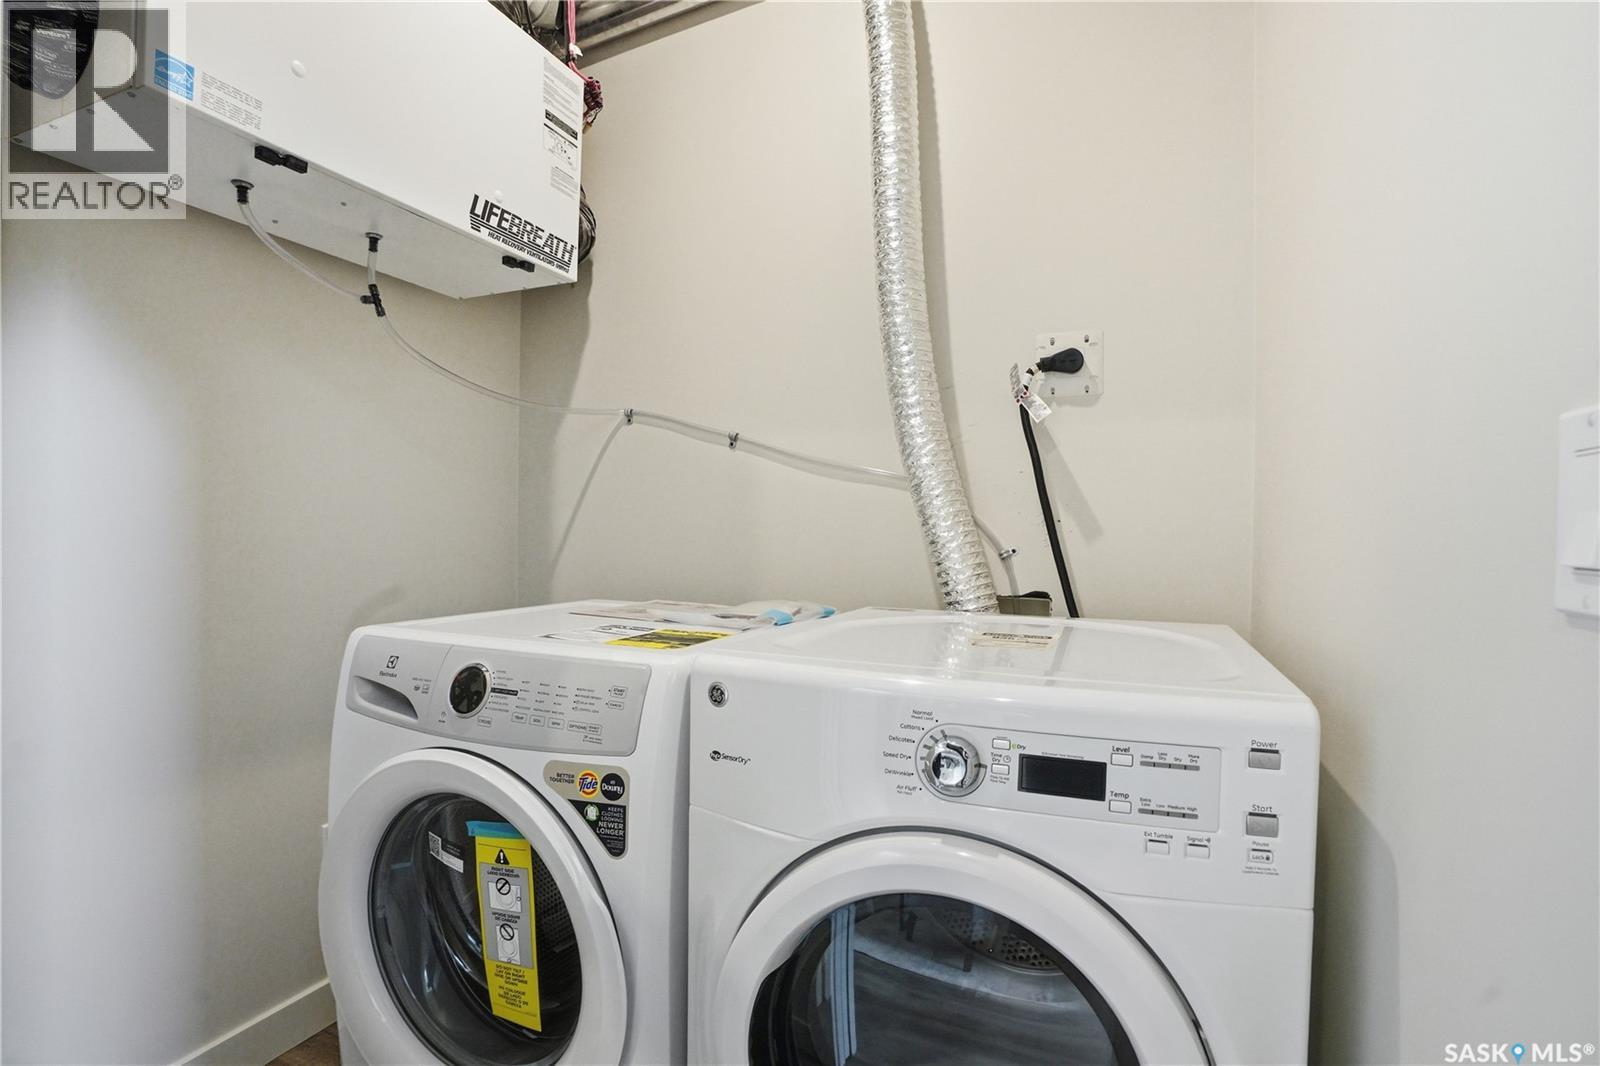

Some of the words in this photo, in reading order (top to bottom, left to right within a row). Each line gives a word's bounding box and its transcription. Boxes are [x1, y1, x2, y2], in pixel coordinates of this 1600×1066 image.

[487, 231, 502, 242] HEAT
[502, 237, 526, 253] RECOVERY
[899, 722, 921, 730] Cottons
[1251, 739, 1278, 749] Power
[1111, 745, 1131, 753] Level
[882, 751, 898, 759] Speed
[899, 753, 910, 761] Dry
[578, 776, 598, 791] Tide
[601, 782, 624, 794] Downy
[1109, 790, 1130, 799] Temp
[1251, 804, 1273, 813] Start
[598, 821, 624, 830] NEWER
[596, 827, 624, 836] LONGER
